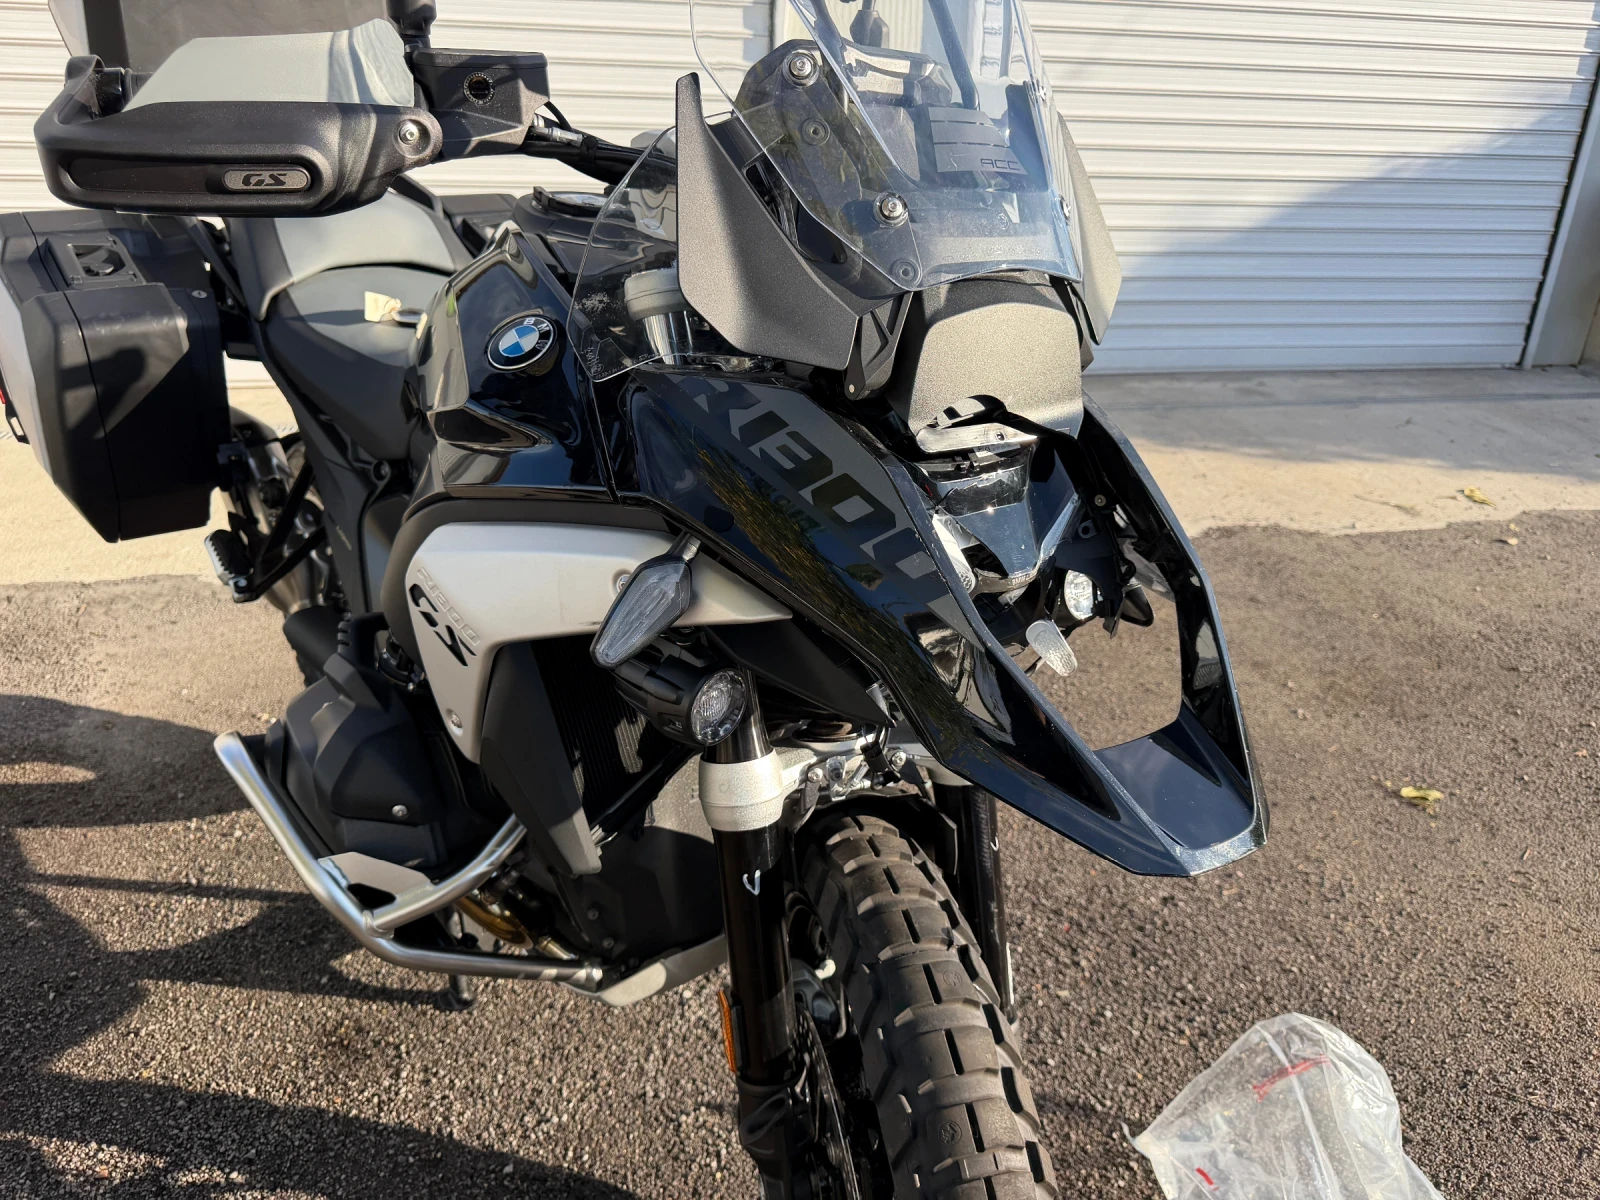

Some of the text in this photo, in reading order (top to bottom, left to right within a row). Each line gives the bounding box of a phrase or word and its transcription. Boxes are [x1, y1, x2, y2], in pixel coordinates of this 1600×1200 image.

[980, 158, 1021, 171] ACC
[241, 173, 288, 187] GS
[523, 317, 551, 351] BMW
[409, 583, 477, 667] GS
